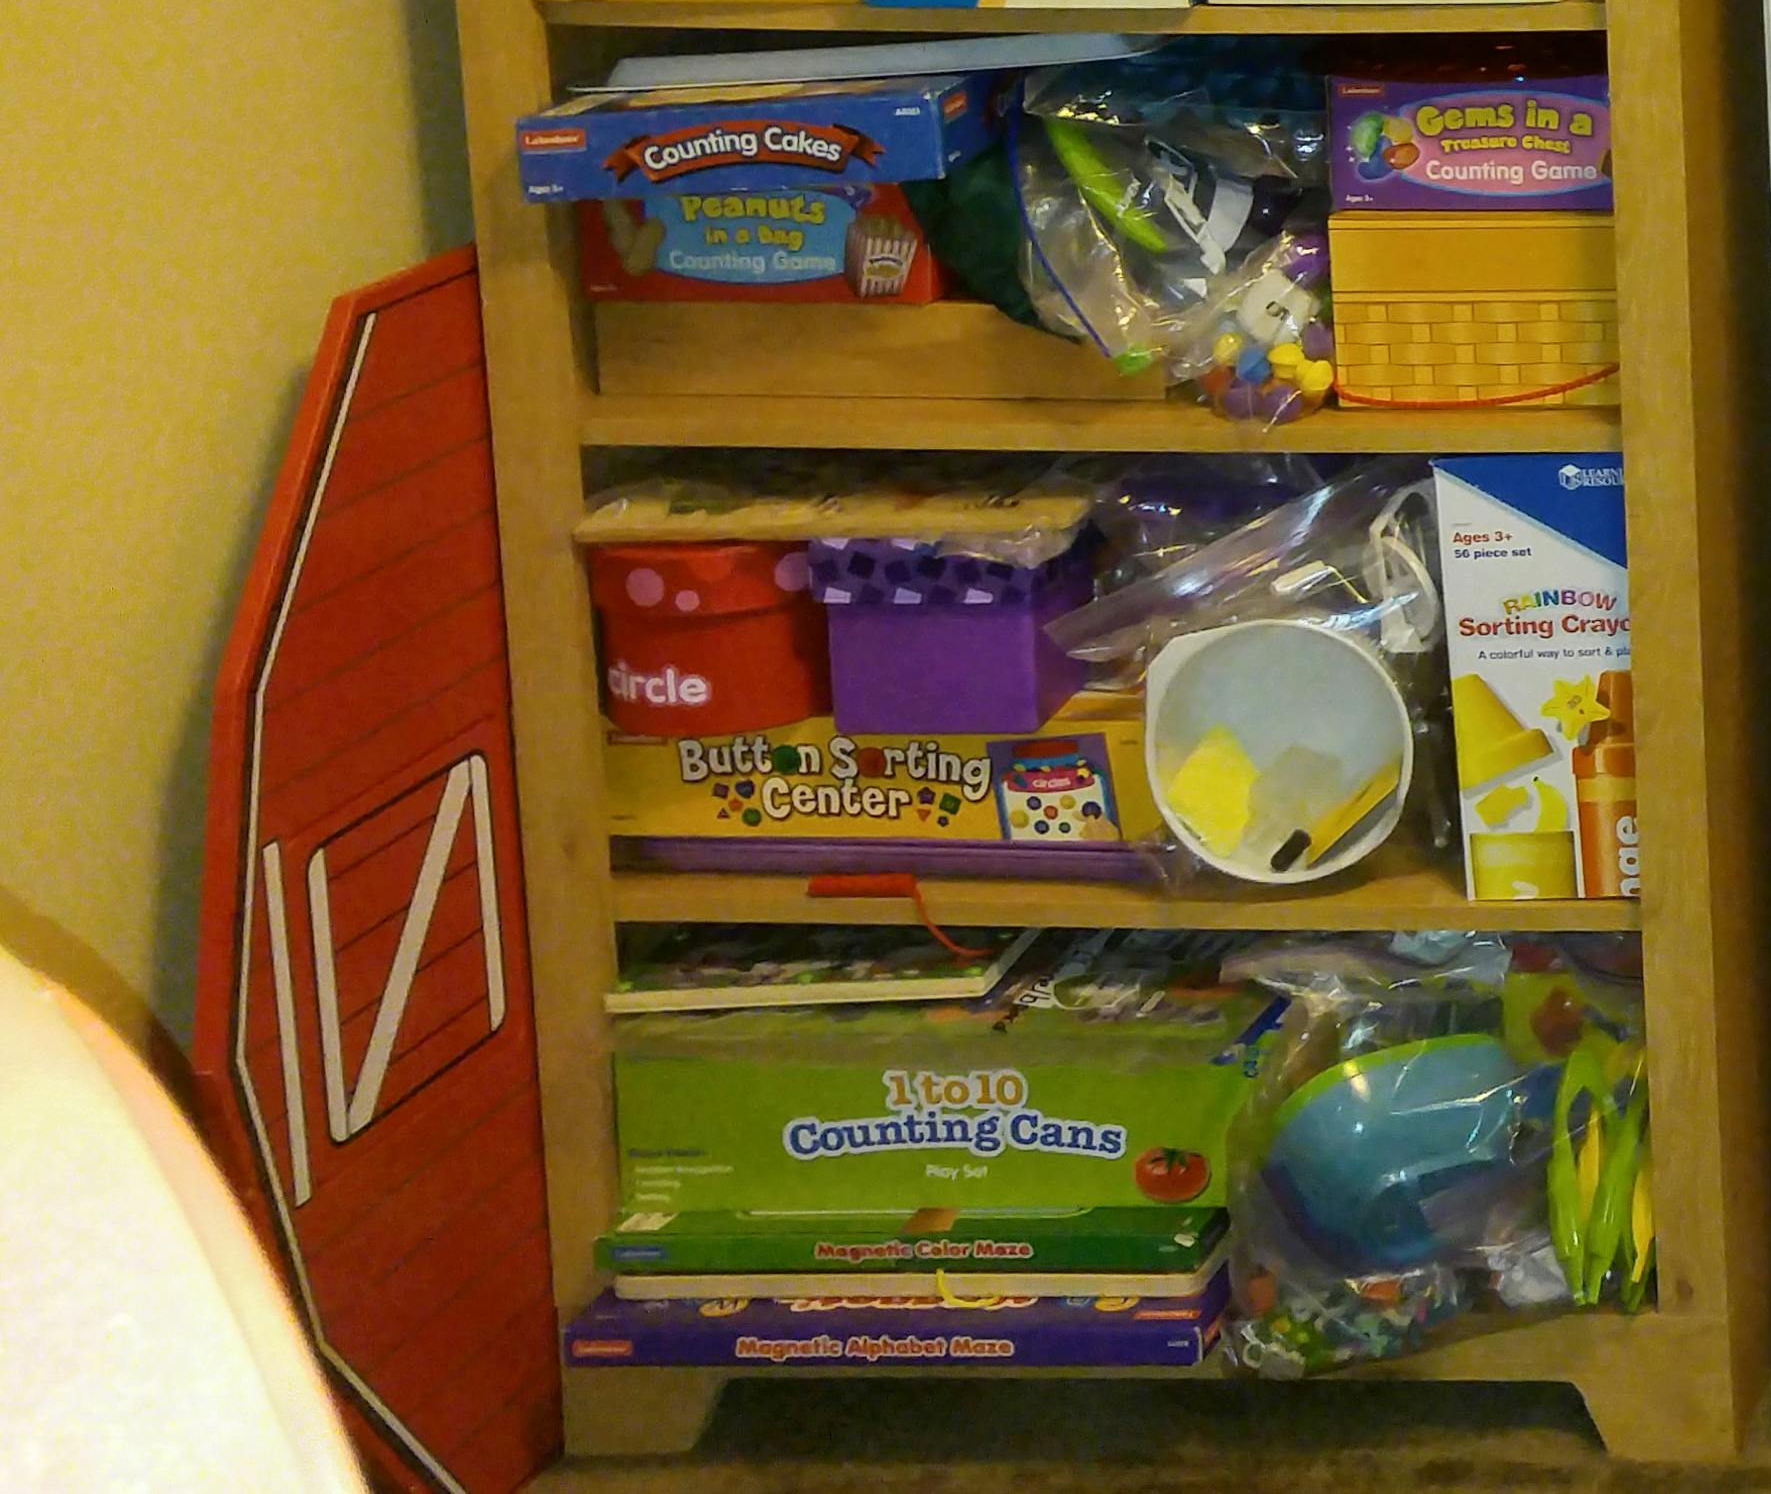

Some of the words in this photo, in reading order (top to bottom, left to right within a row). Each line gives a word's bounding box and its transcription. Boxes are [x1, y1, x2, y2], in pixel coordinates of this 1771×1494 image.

[1415, 102, 1515, 138] Gems
[1526, 101, 1560, 130] in
[1570, 110, 1593, 137] a
[643, 129, 759, 171] Counting
[763, 126, 842, 163] Cakes
[1473, 548, 1507, 561] piece
[1512, 546, 1532, 557] set
[1503, 589, 1618, 615] RAINBOW
[789, 1113, 1002, 1154] Counting
[1010, 1116, 1124, 1154] Cans
